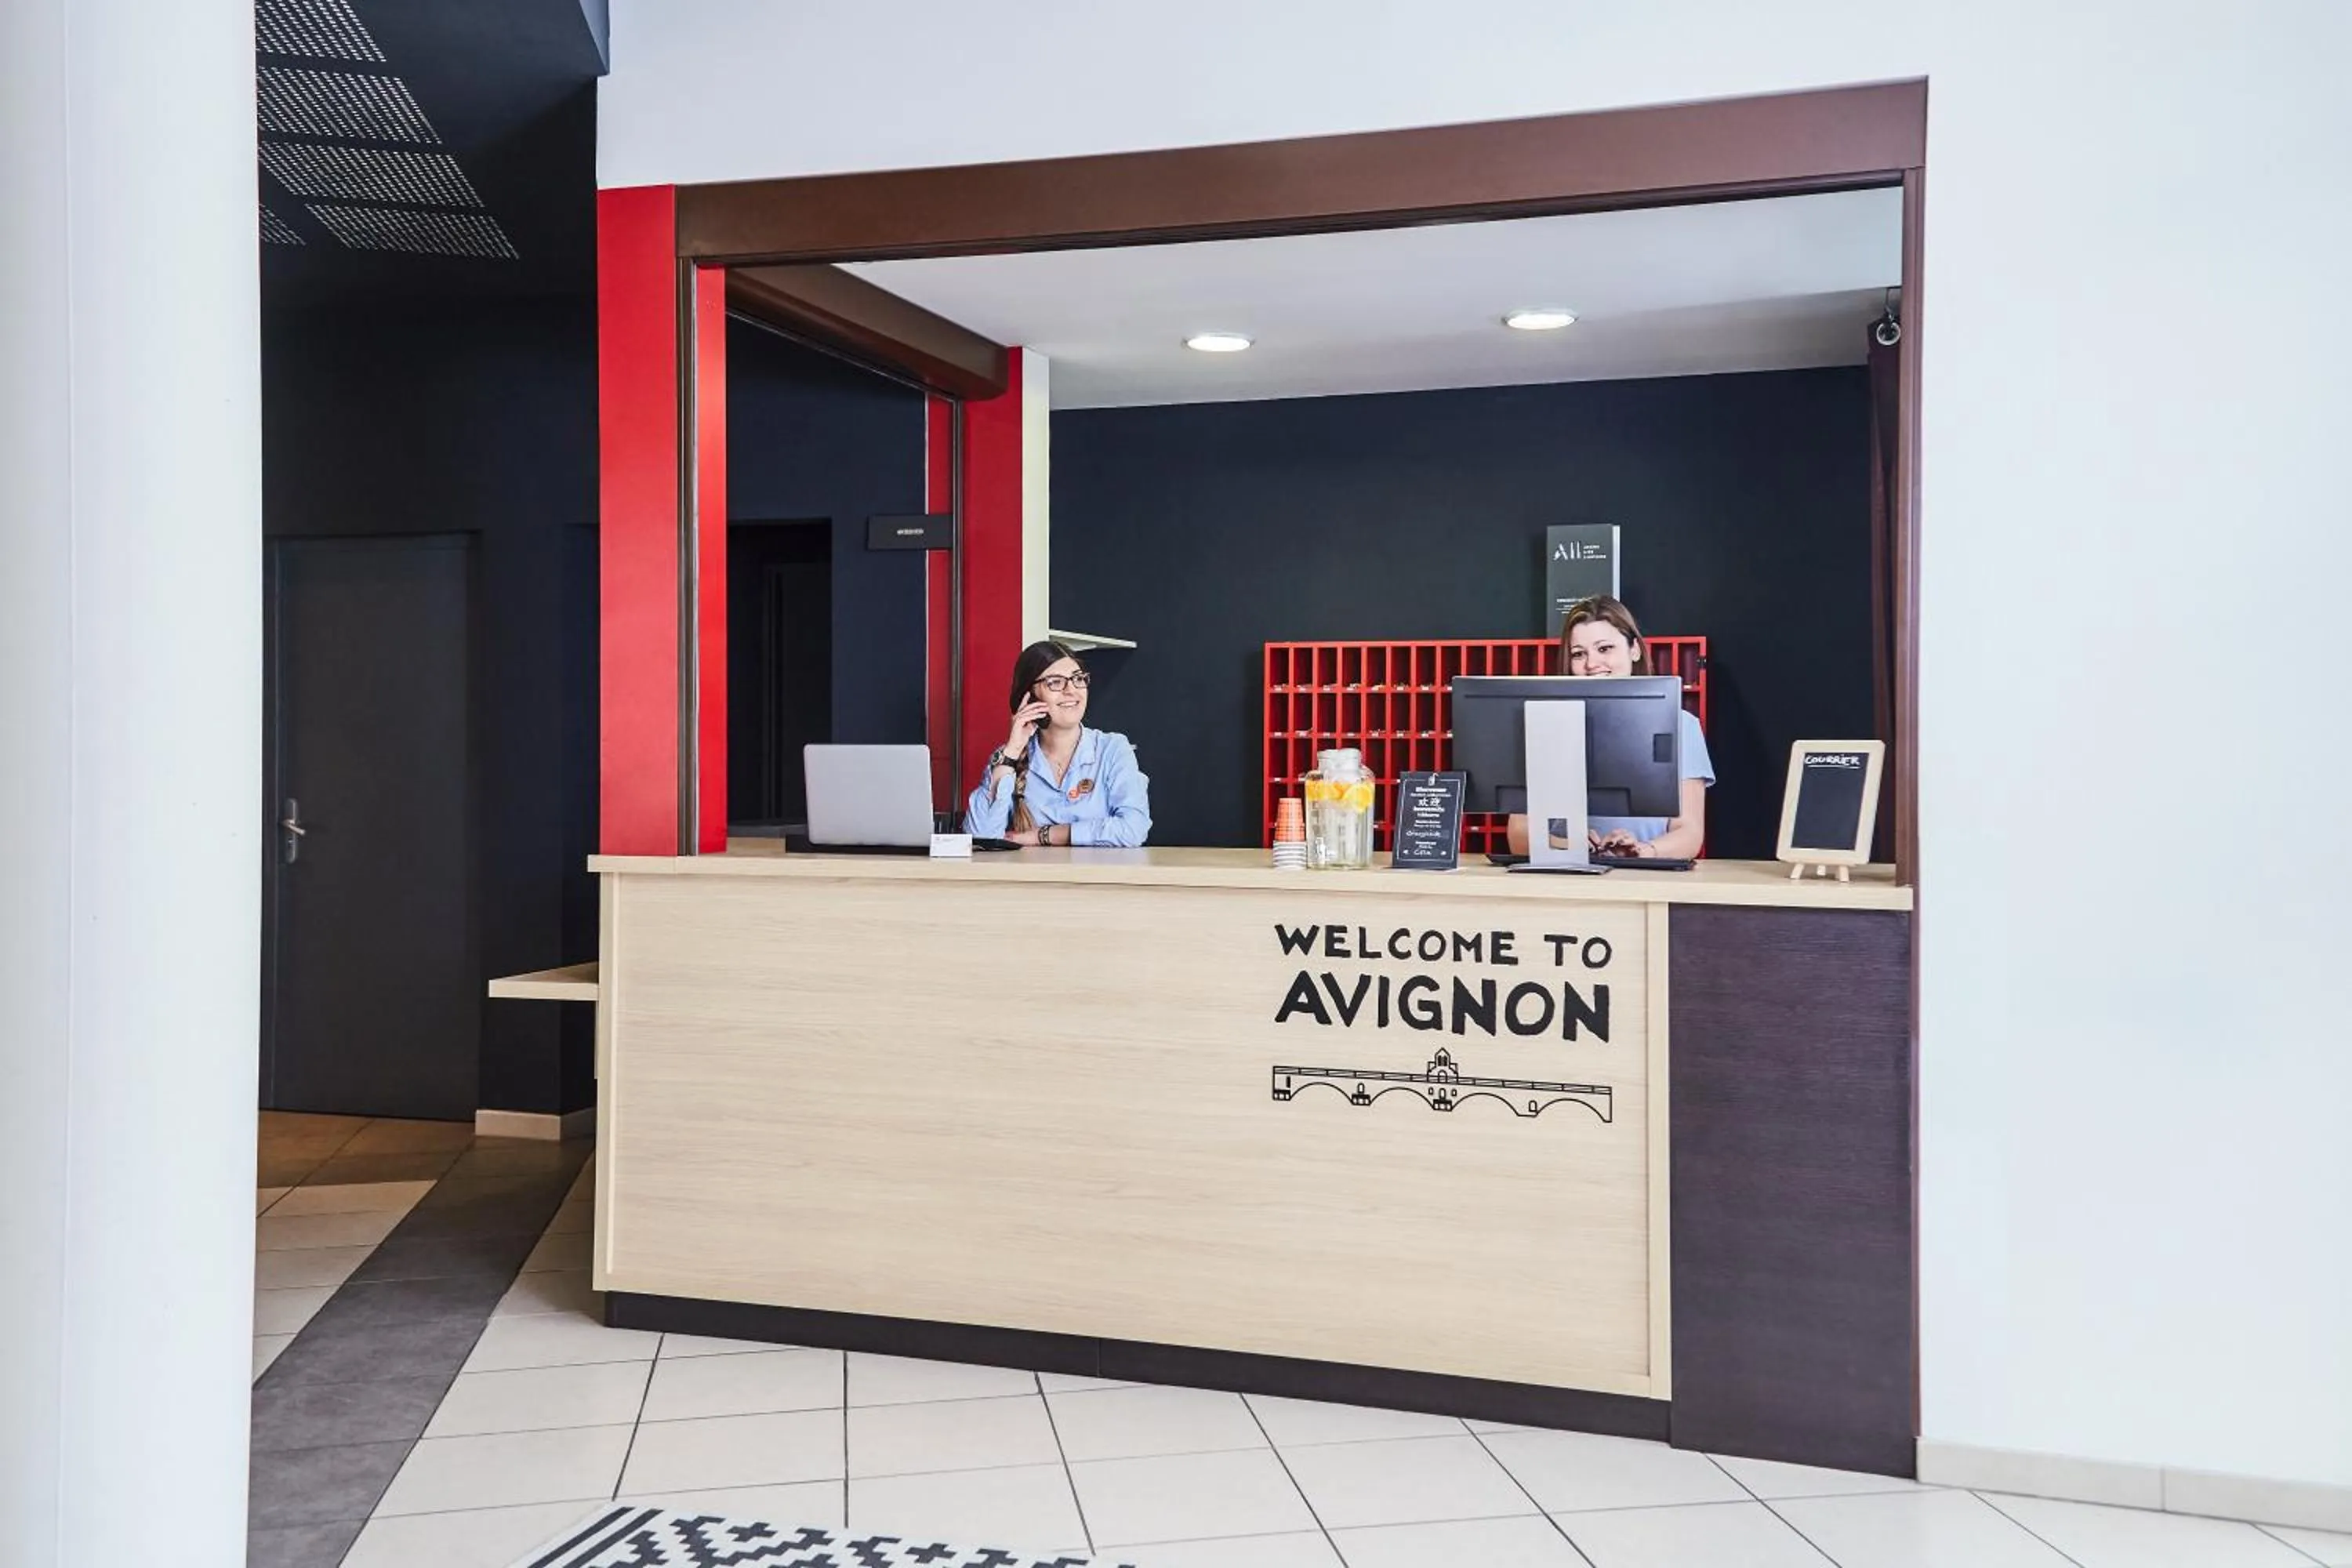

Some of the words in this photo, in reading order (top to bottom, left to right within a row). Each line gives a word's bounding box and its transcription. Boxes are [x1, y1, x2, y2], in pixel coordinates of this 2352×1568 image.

[1274, 924, 1519, 966] WELCOME
[1544, 934, 1613, 969] TO
[1274, 970, 1610, 1044] AVIGNON
